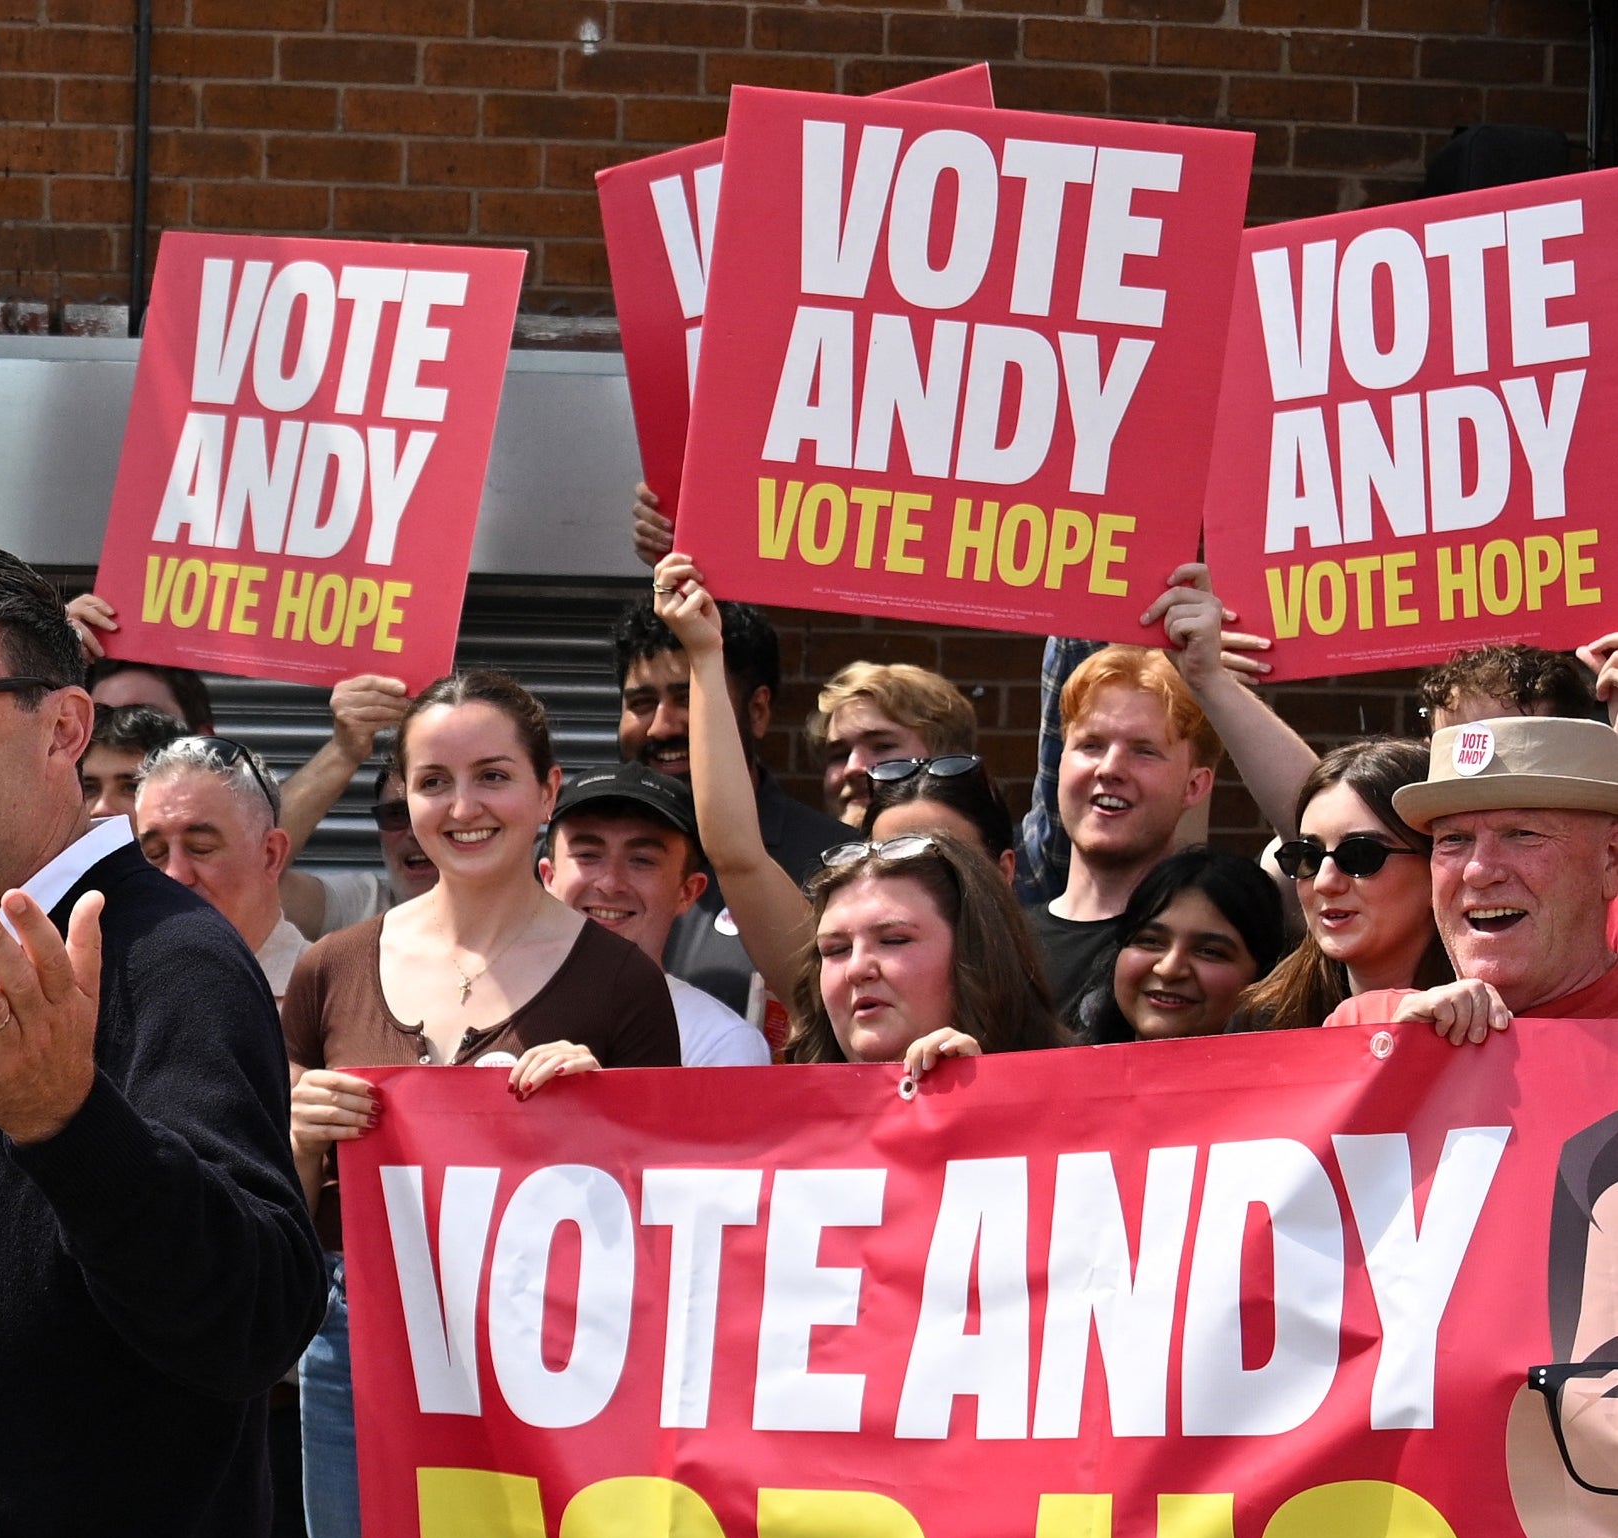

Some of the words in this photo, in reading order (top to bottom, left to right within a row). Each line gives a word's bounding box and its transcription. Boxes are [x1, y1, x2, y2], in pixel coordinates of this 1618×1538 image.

[800, 118, 1185, 329] VOTE
[1250, 198, 1593, 403] VOTE
[190, 257, 470, 423] VOTE
[760, 305, 1156, 496] ANDY
[151, 412, 438, 567] ANDY
[758, 478, 933, 574] VOTE
[947, 499, 1137, 597] HOPE
[1263, 368, 1588, 555] ANDY
[140, 554, 268, 637] VOTE
[271, 570, 413, 654] HOPE
[1265, 551, 1421, 639] VOTE
[1436, 528, 1602, 622] HOPE
[1457, 749, 1486, 765] ANDY
[1461, 732, 1489, 750] VOTE
[378, 1163, 889, 1434] VOTE
[894, 1124, 1514, 1441] ANDY
